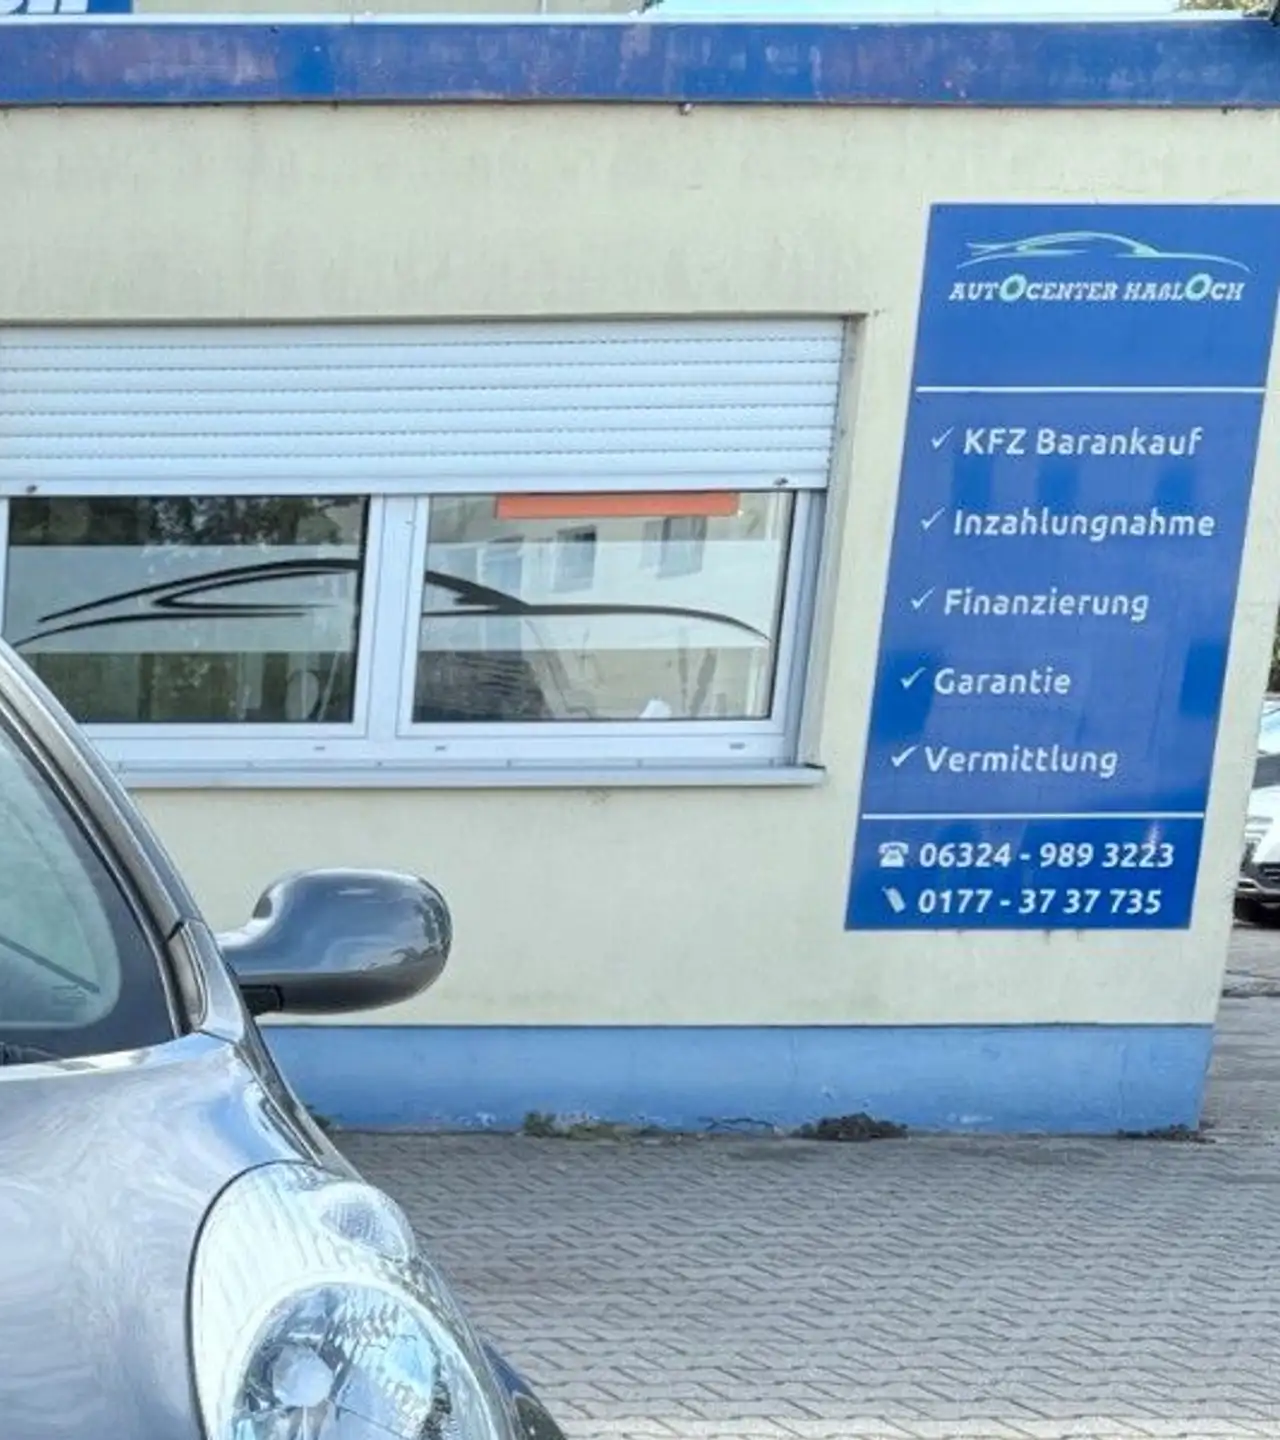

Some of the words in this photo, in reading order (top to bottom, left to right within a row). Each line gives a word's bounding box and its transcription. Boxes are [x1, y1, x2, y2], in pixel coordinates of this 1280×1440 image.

[948, 273, 1119, 301] AUTOCENTER
[963, 427, 1028, 455] KFZ
[1036, 426, 1204, 455] Barankauf
[953, 507, 1216, 543] Inzahlungnahme
[943, 586, 1150, 622] Finanzierung
[933, 666, 1072, 695] Garantie
[924, 744, 1119, 779] Vermittlung
[918, 842, 1012, 868] 06324
[1039, 842, 1094, 868] 989
[1100, 842, 1175, 868] 3223
[917, 888, 994, 914] 0177
[1018, 889, 1057, 914] 37
[1063, 889, 1101, 914] 37
[1109, 888, 1163, 915] 735
